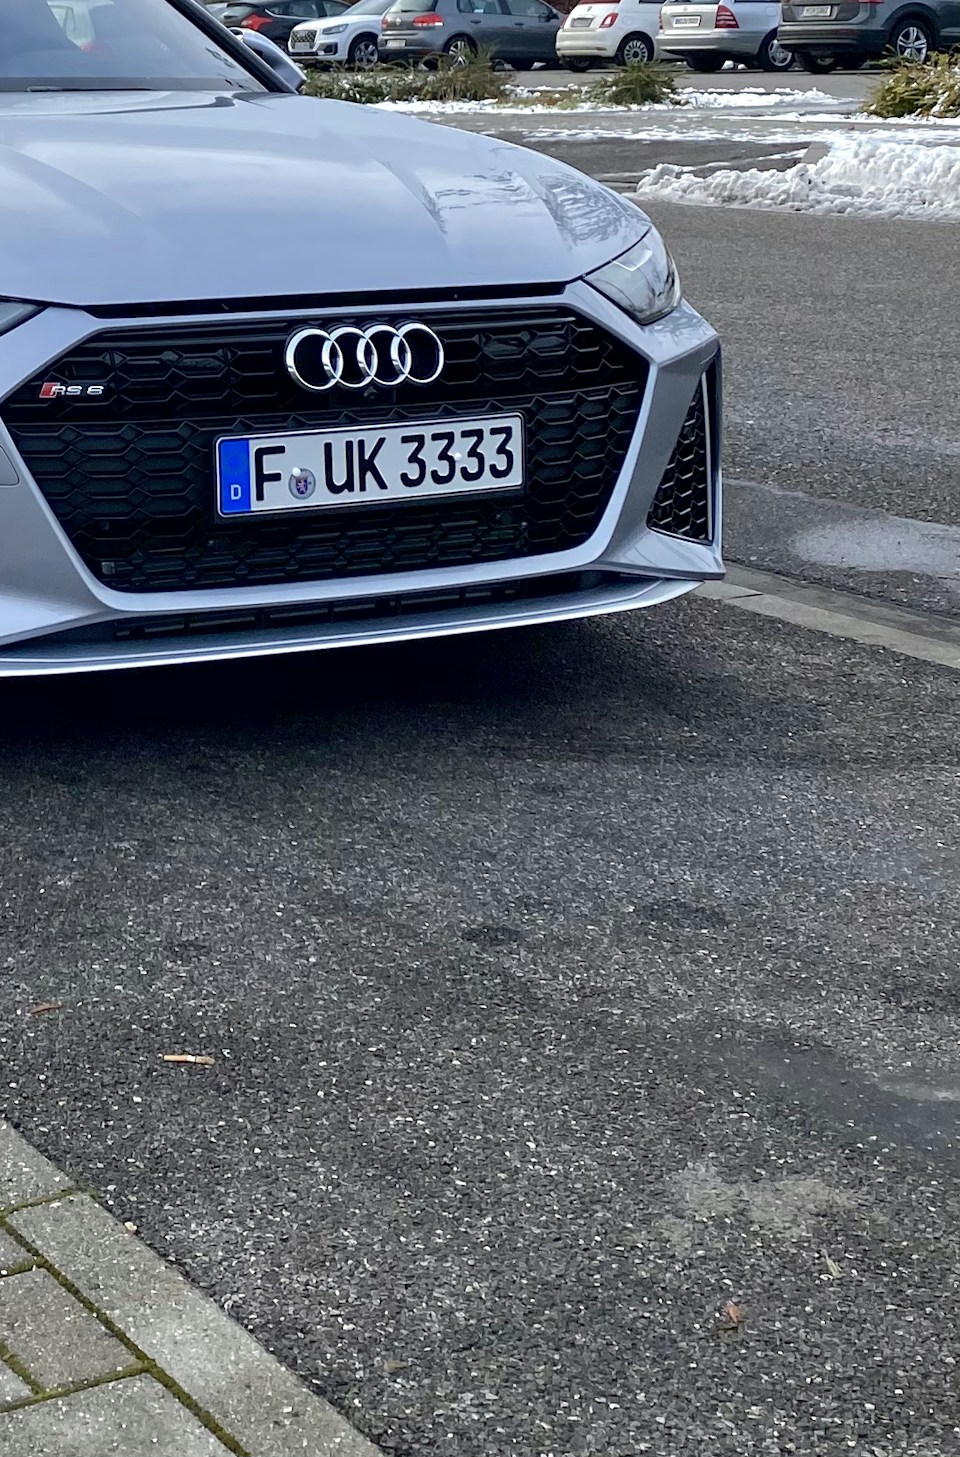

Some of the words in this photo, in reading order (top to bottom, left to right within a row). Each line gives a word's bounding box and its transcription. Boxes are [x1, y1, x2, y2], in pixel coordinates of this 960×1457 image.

[49, 385, 82, 395] RS
[87, 385, 104, 395] 6
[253, 444, 286, 502] F
[323, 436, 388, 495] UK
[399, 425, 515, 488] 3333
[230, 483, 243, 501] D
